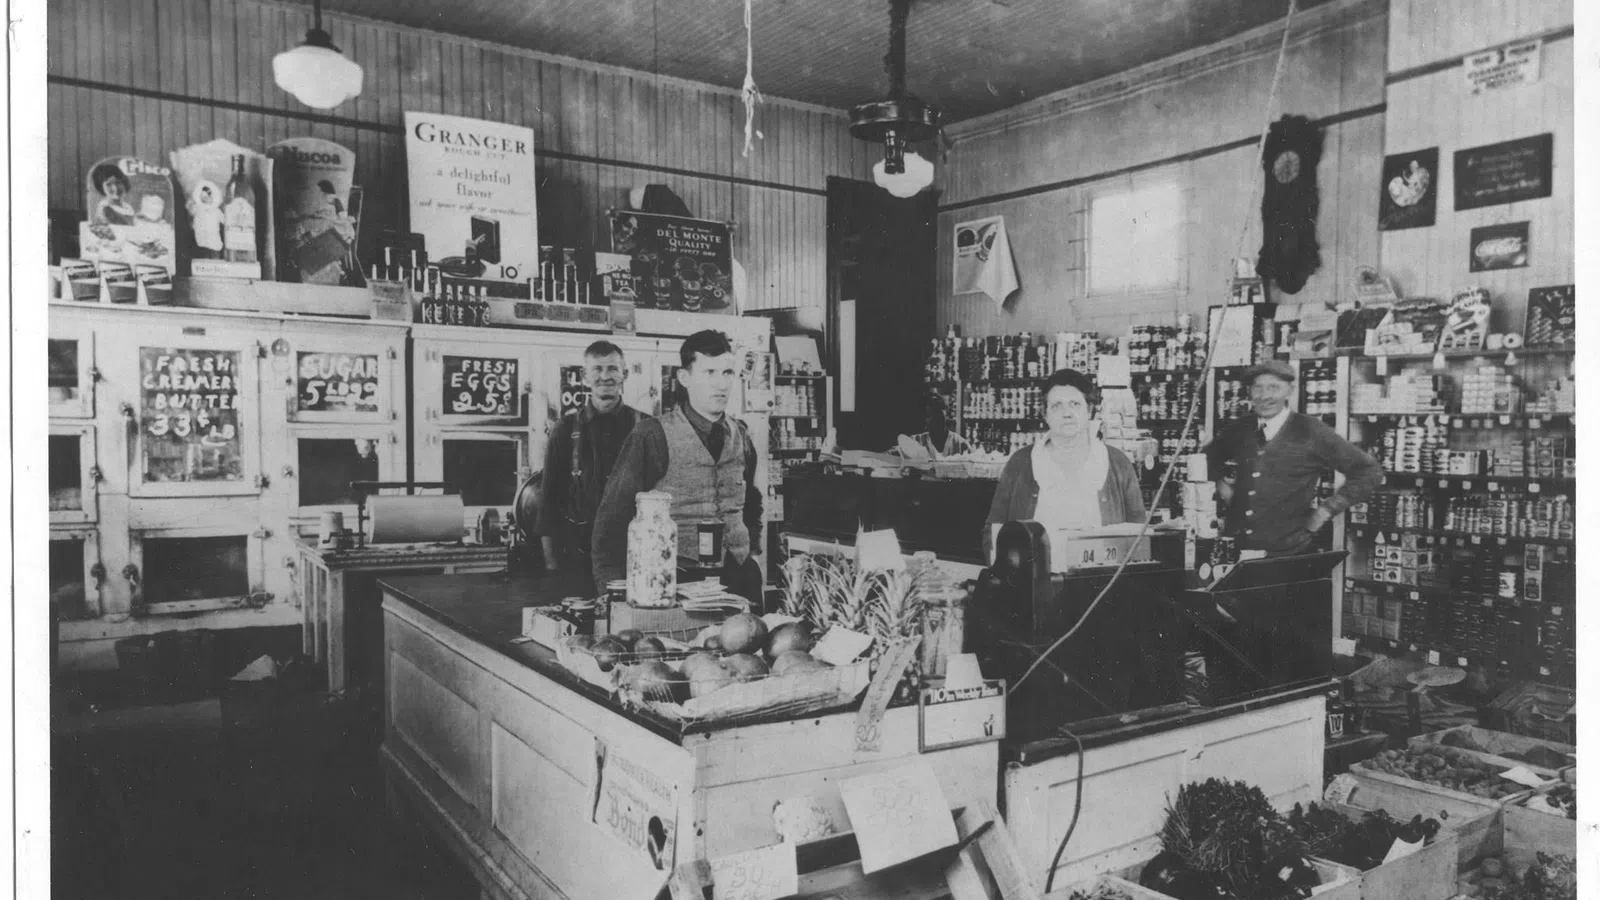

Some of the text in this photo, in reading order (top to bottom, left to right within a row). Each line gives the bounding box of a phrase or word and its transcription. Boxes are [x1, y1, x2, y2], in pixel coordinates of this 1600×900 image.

[415, 122, 527, 155] GRANGER
[437, 166, 511, 185] a delightful
[456, 182, 493, 198] flavor
[657, 228, 722, 244] DEL MONTE
[669, 238, 711, 250] QUALITY
[156, 354, 230, 372] FRESH
[462, 360, 515, 374] FRESH
[451, 372, 511, 393] EGGS
[306, 380, 326, 405] 5
